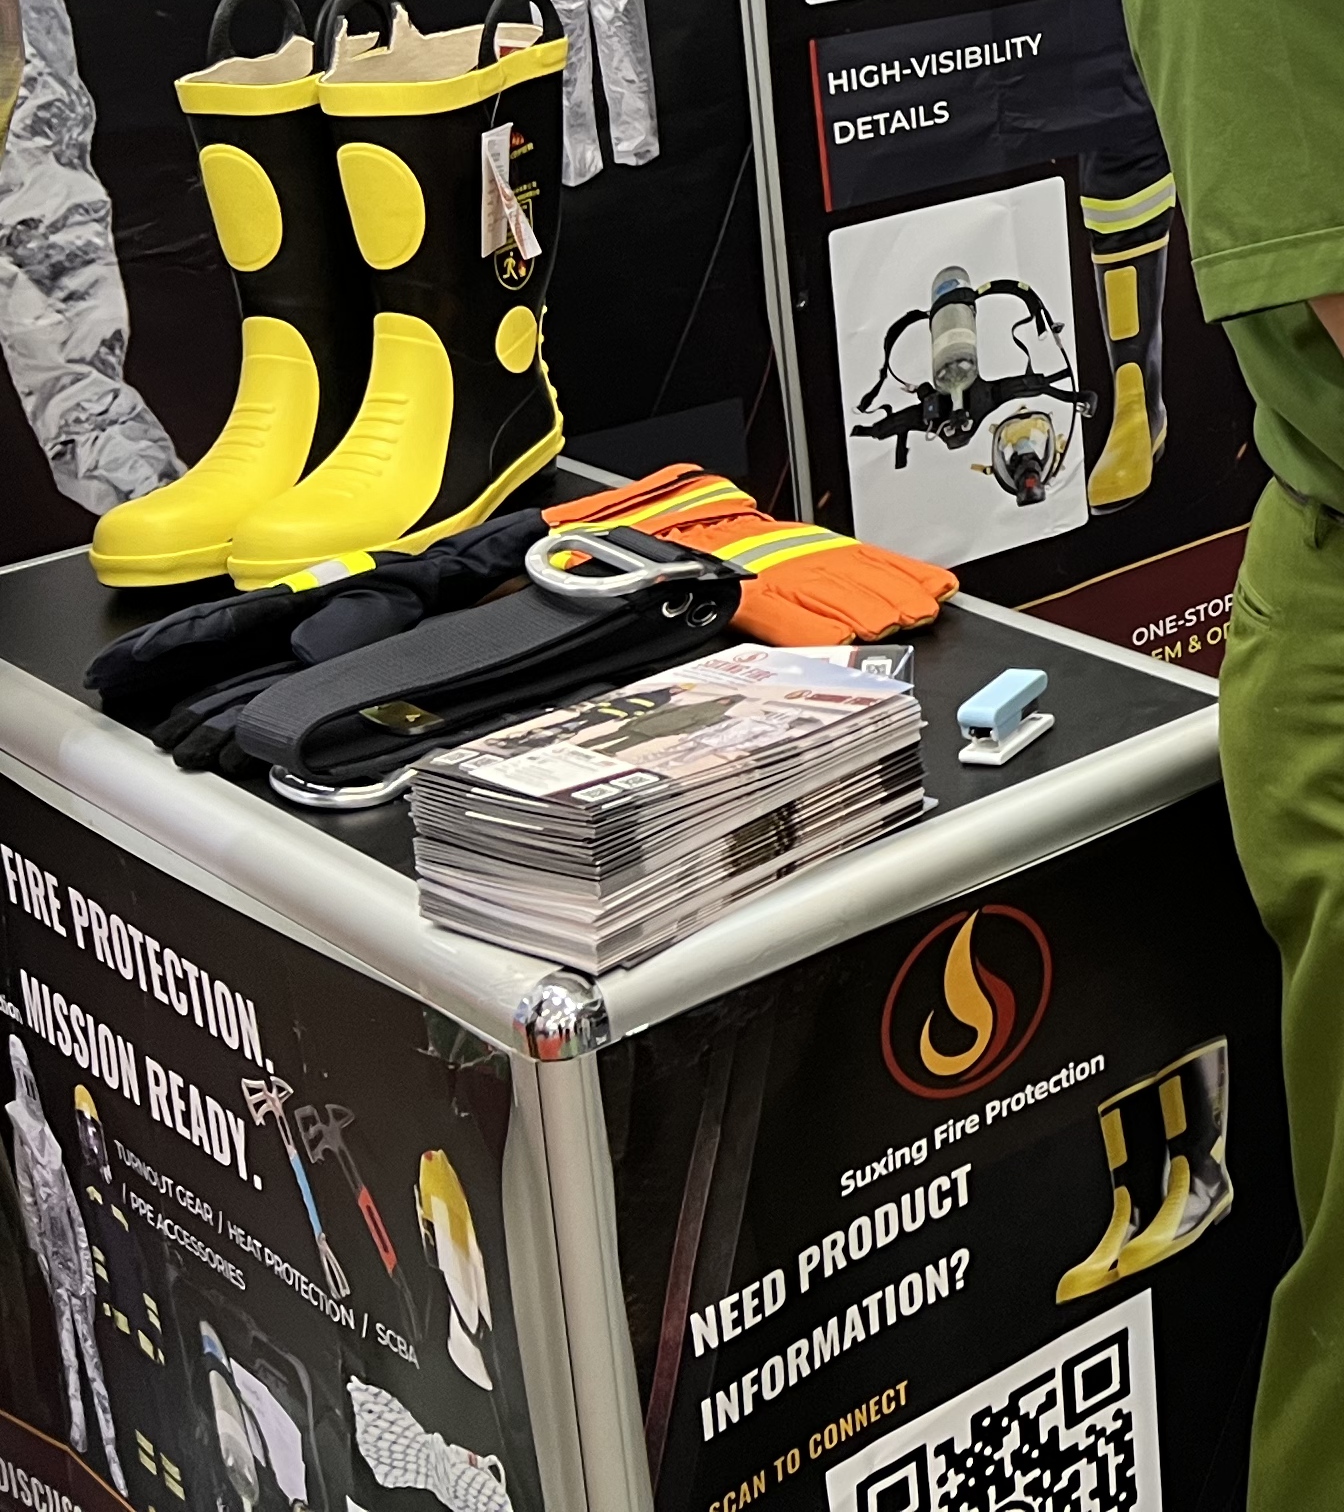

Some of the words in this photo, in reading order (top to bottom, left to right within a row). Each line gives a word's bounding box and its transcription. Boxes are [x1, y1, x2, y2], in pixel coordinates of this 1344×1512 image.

[828, 33, 1041, 94] HIGH-VISIBILITY
[834, 101, 949, 144] DETAILS
[1151, 641, 1182, 662] EM
[1189, 635, 1201, 653] &
[0, 844, 66, 937] FIRE
[68, 887, 274, 1074] PROTECTION.
[20, 969, 140, 1105] MISSION
[146, 1056, 262, 1190] READY.
[841, 1138, 927, 1196] Suxing
[934, 1114, 979, 1149] Fire
[986, 1055, 1104, 1124] Protection
[114, 1140, 173, 1197] TURNOUT
[176, 1186, 213, 1226] GEAR
[228, 1221, 262, 1261] HEAT
[264, 1248, 355, 1329] PROTECTION
[376, 1323, 419, 1369] SCBA
[130, 1192, 155, 1226] PPE
[156, 1214, 245, 1290] ACCESSORIES
[690, 1269, 785, 1357] NEED
[799, 1164, 971, 1293] PRODUCT
[701, 1248, 969, 1441] INFORMATION?
[774, 1448, 800, 1482] TO
[809, 1380, 907, 1459] CONNECT
